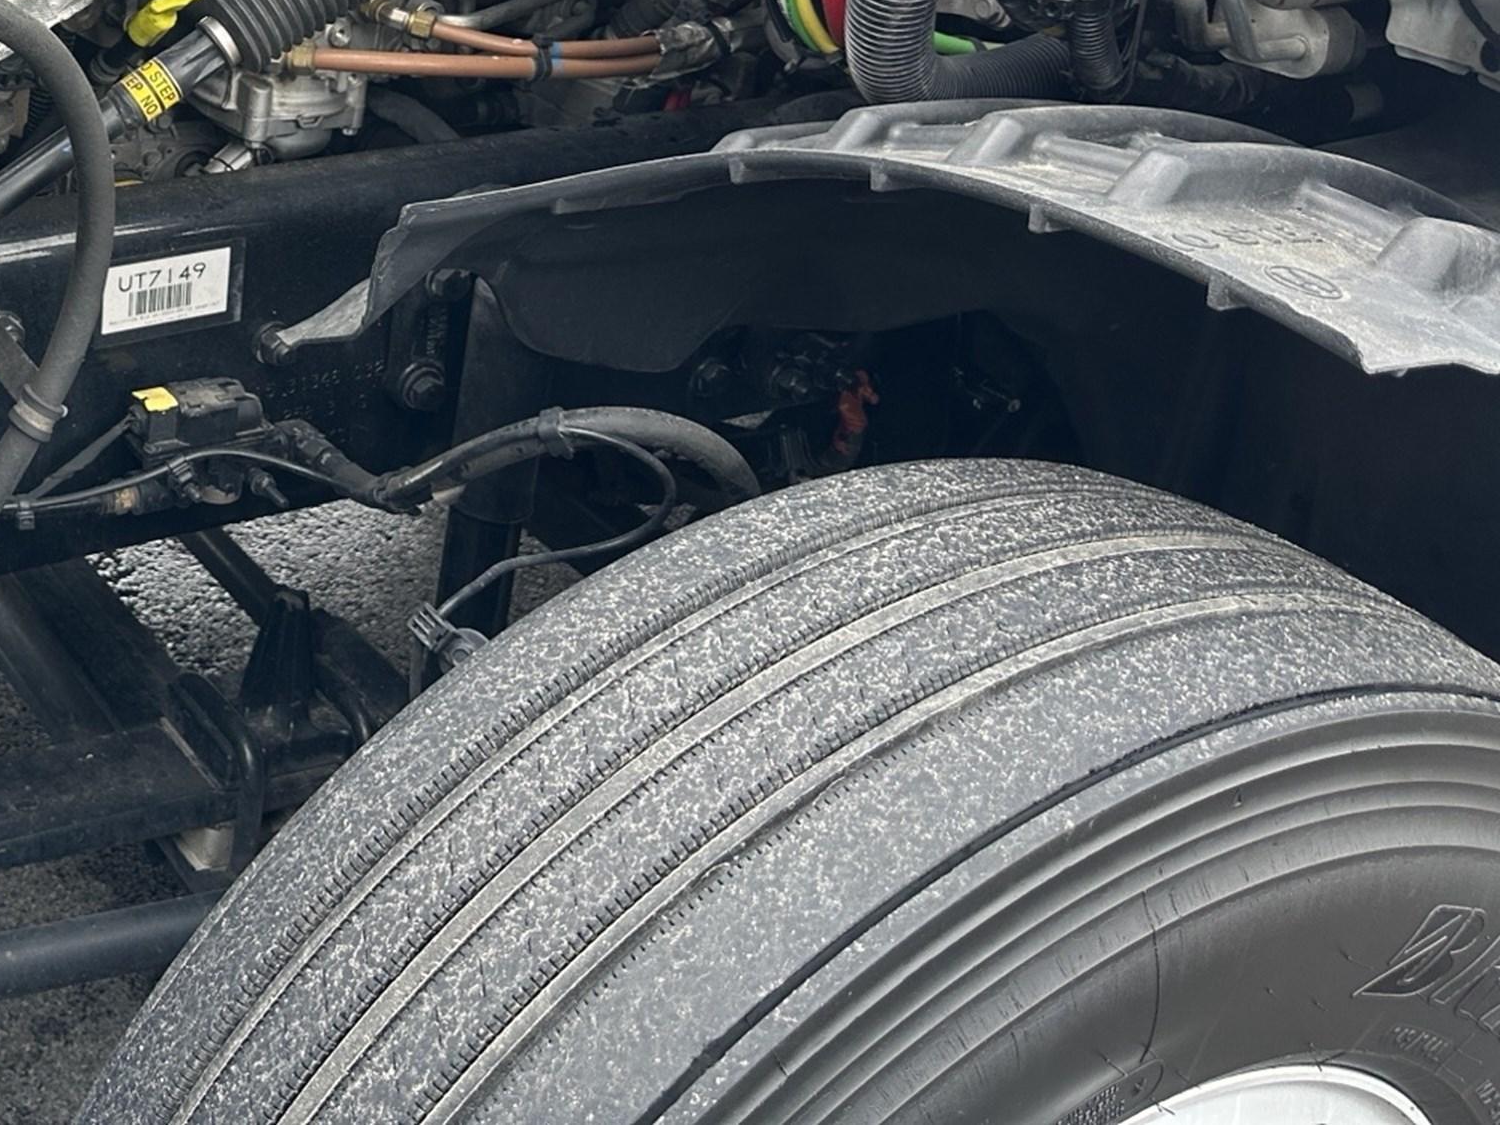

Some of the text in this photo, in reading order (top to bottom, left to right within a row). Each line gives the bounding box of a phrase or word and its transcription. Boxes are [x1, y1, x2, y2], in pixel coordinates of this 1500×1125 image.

[150, 71, 176, 103] STEP
[140, 95, 160, 115] NO
[118, 262, 207, 293] UT7149
